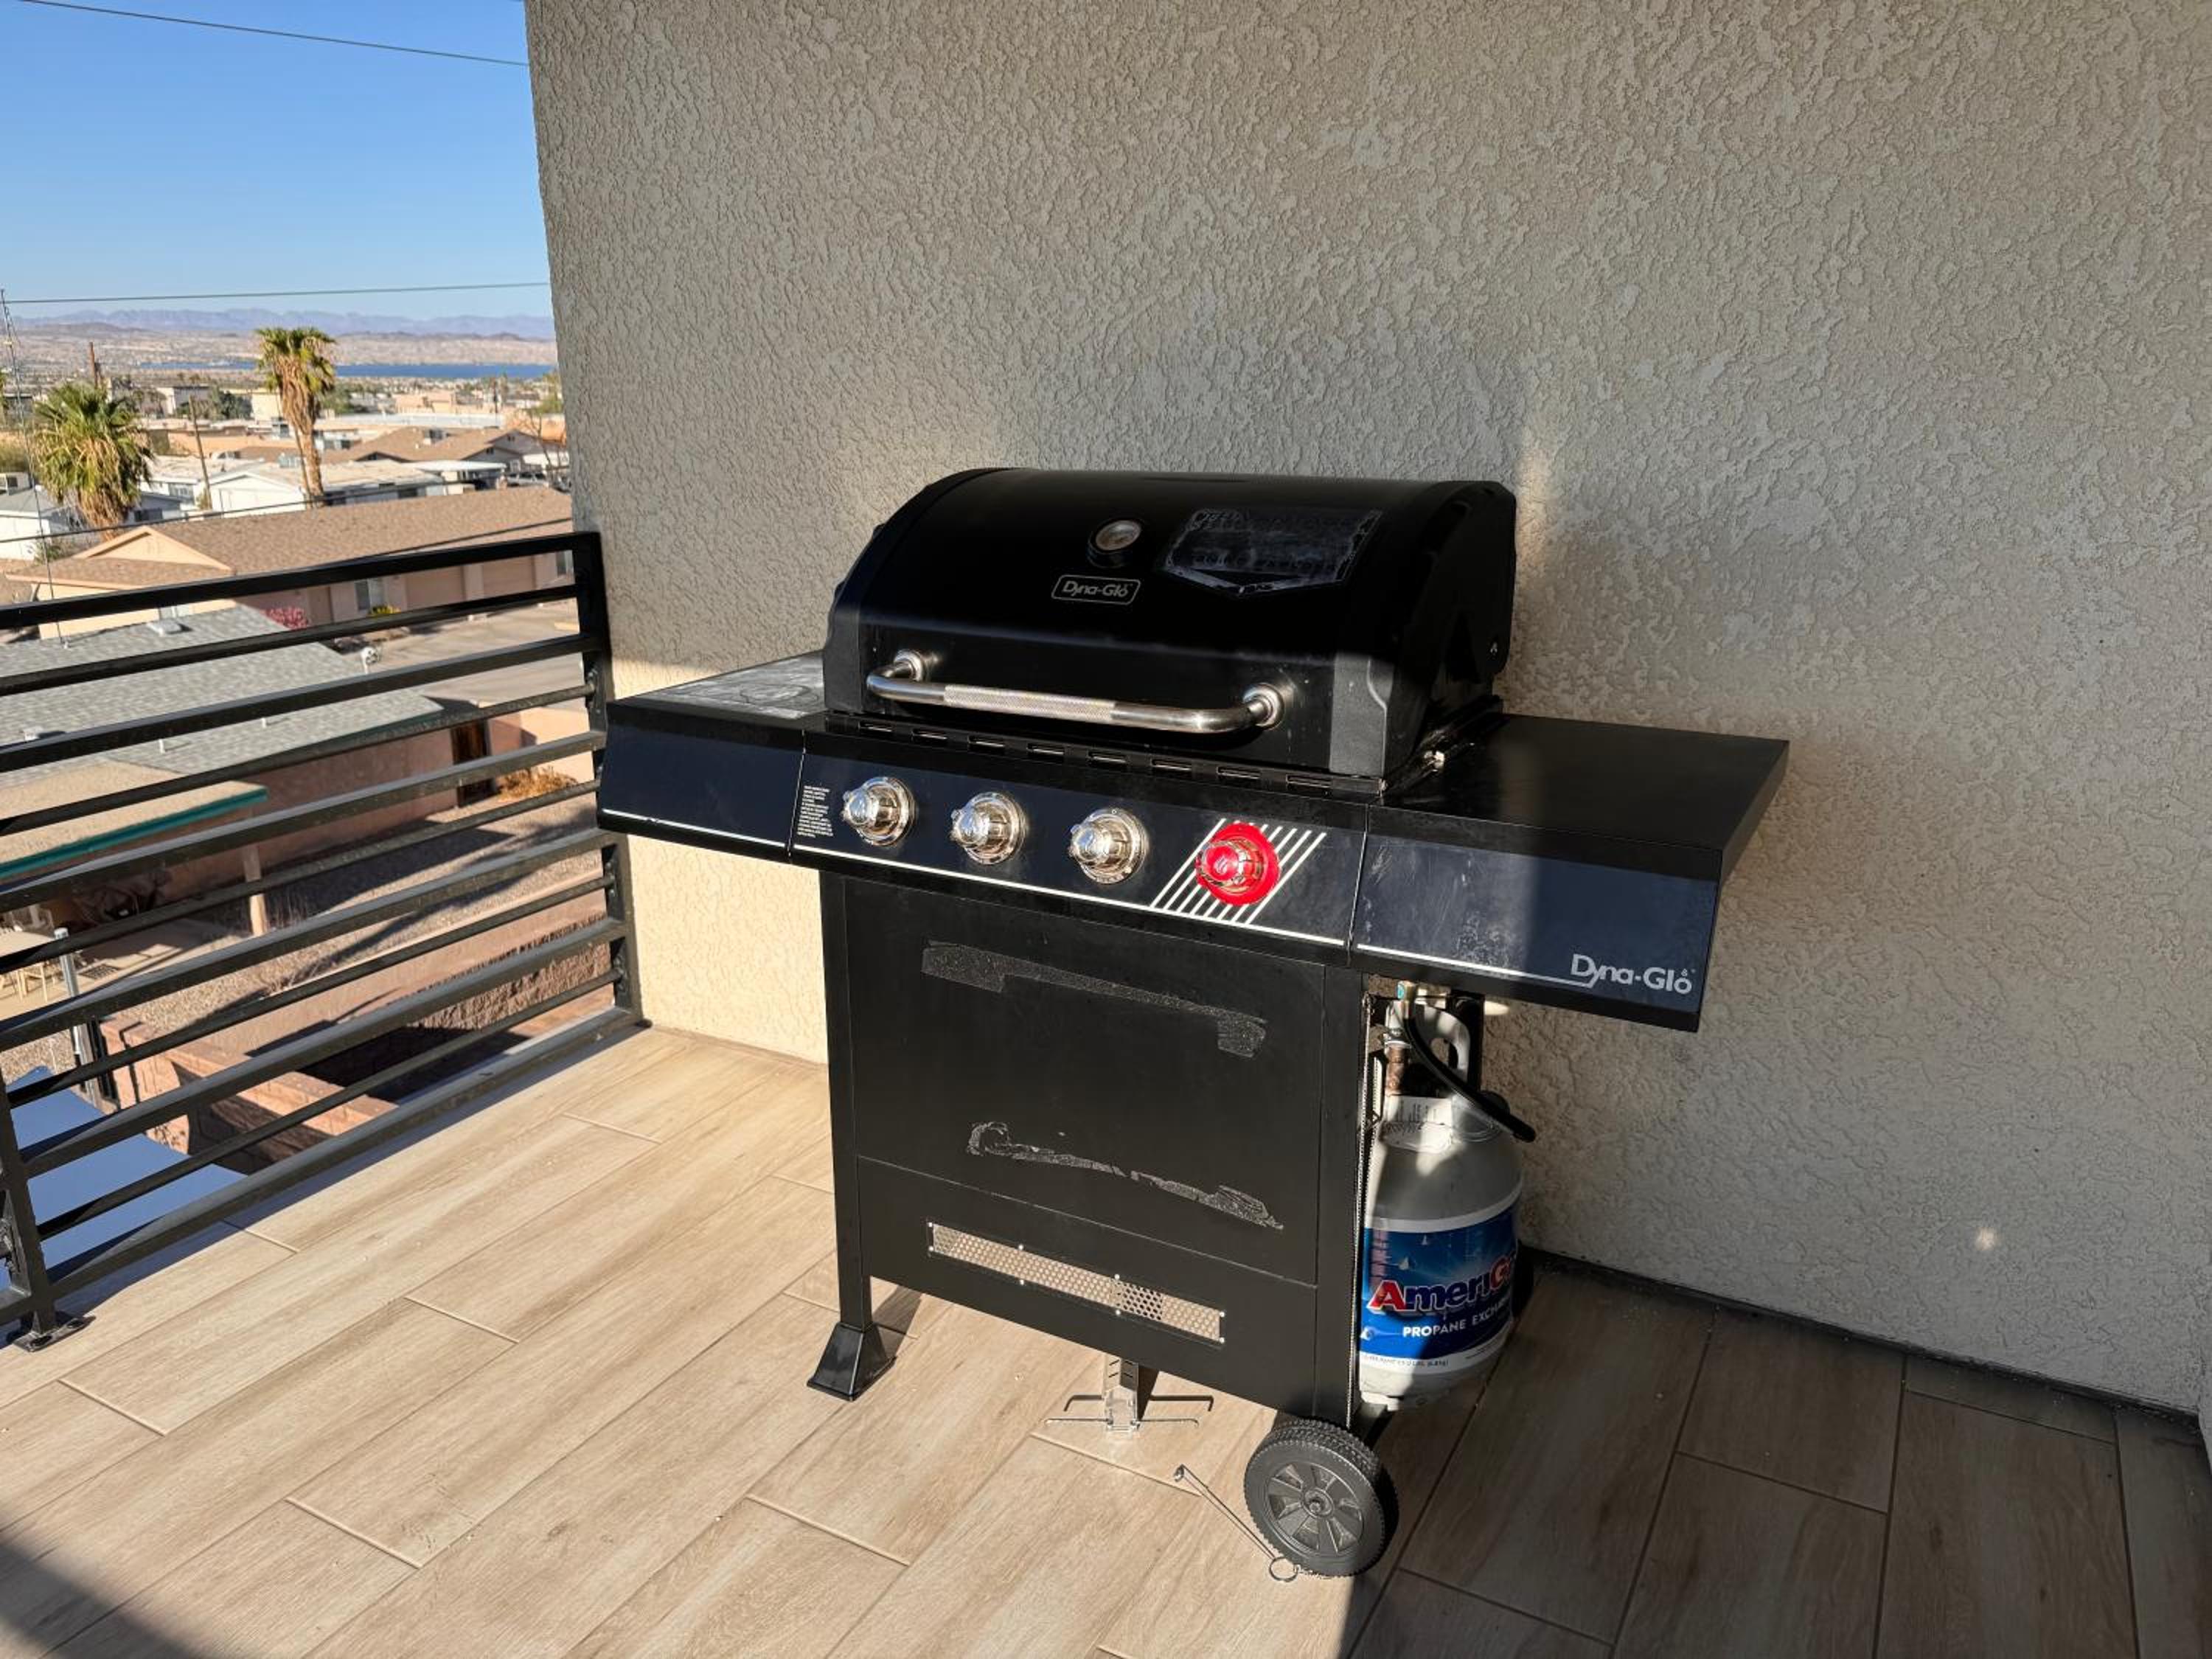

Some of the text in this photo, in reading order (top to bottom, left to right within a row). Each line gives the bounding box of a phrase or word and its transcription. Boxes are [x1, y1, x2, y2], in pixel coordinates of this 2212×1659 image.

[1061, 580, 1129, 597] Dyna-Glo
[1571, 953, 1692, 995] Dyna-Glo
[1402, 1319, 1467, 1338] PROPANE
